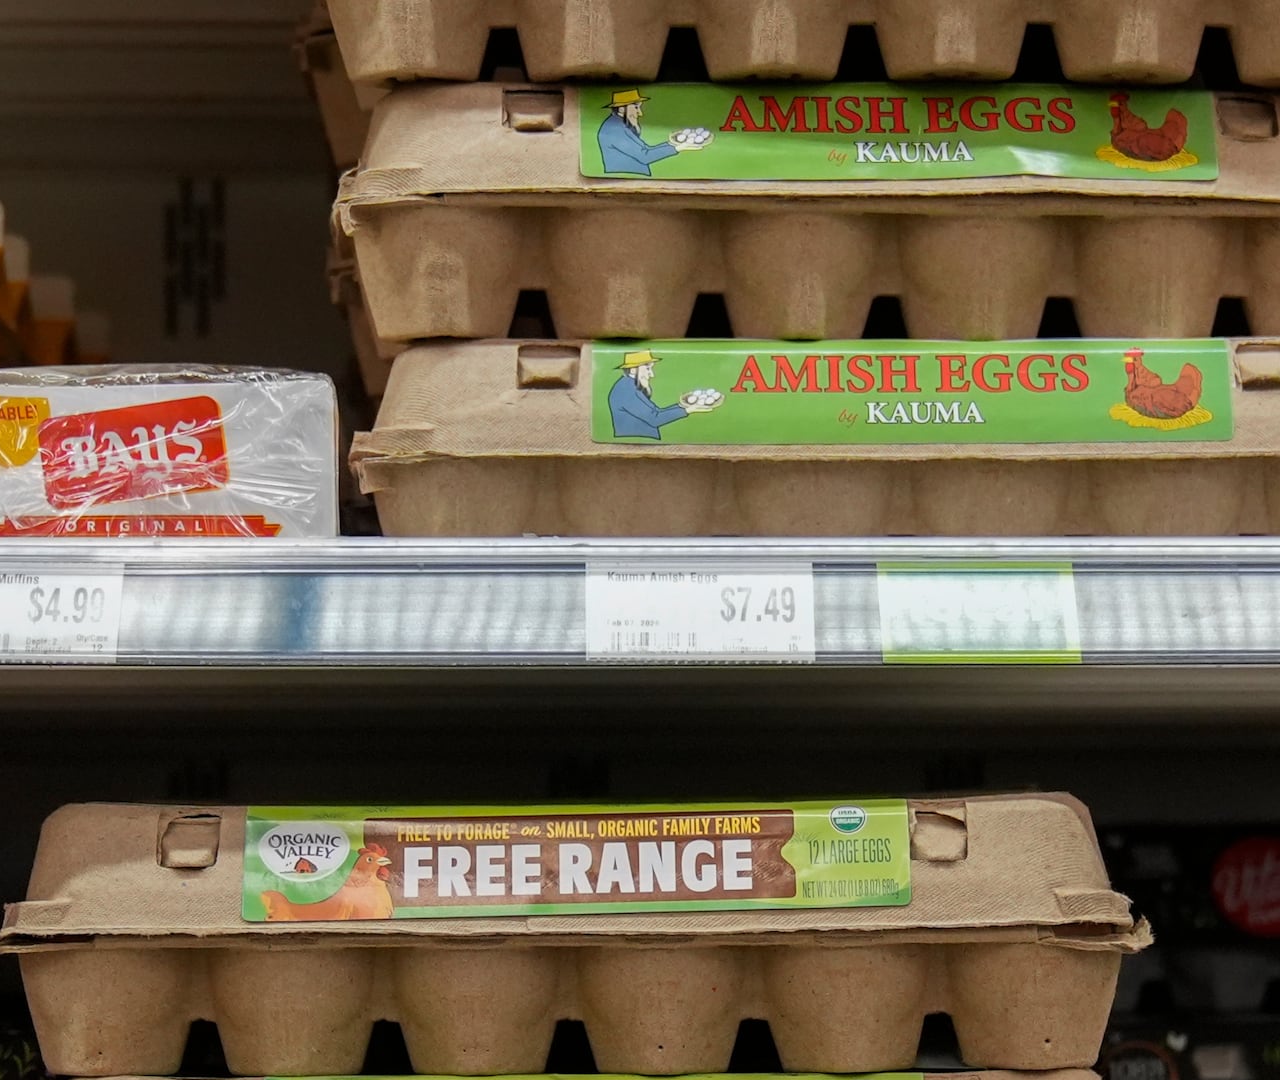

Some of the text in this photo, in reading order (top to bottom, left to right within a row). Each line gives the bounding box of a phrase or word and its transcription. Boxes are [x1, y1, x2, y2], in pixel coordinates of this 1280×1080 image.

[721, 94, 1076, 134] AMISH EGGS
[854, 141, 975, 165] KAUMA
[729, 352, 1090, 394] AMISH EGGS
[865, 400, 985, 425] KAUMA
[64, 519, 204, 532] ORIGINAL
[607, 571, 646, 583] Kauma
[650, 571, 686, 583] Amish
[27, 586, 105, 624] $4.99
[720, 586, 797, 624] $7.49
[402, 839, 753, 898] FREE RANGE
